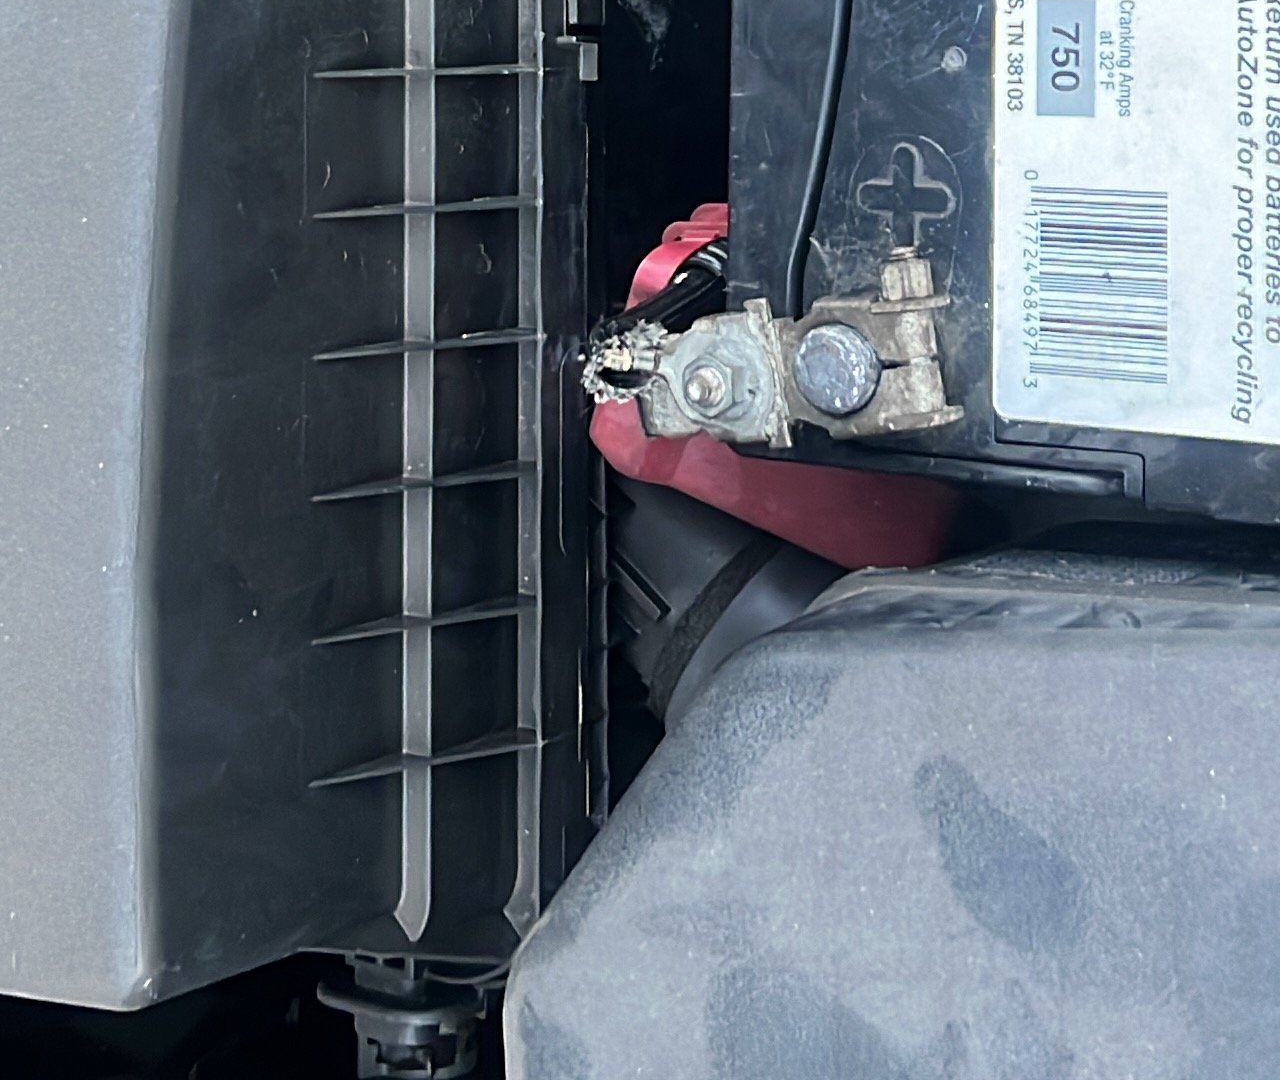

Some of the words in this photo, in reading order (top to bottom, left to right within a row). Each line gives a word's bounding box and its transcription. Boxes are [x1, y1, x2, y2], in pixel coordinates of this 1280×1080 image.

[1007, 21, 1024, 46] TN
[1051, 22, 1080, 92] 750
[1100, 30, 1114, 45] at
[1117, 0, 1134, 68] Cranking
[1006, 52, 1024, 112] 38103
[1099, 50, 1115, 90] 32°F
[1116, 73, 1134, 117] Amps
[1023, 171, 1036, 180] 0
[1236, 137, 1258, 174] for
[1024, 210, 1038, 272] 17724
[1232, 186, 1255, 284] proper
[1023, 285, 1038, 350] 68497
[1023, 378, 1037, 388] 3
[1230, 292, 1255, 425] recycling
